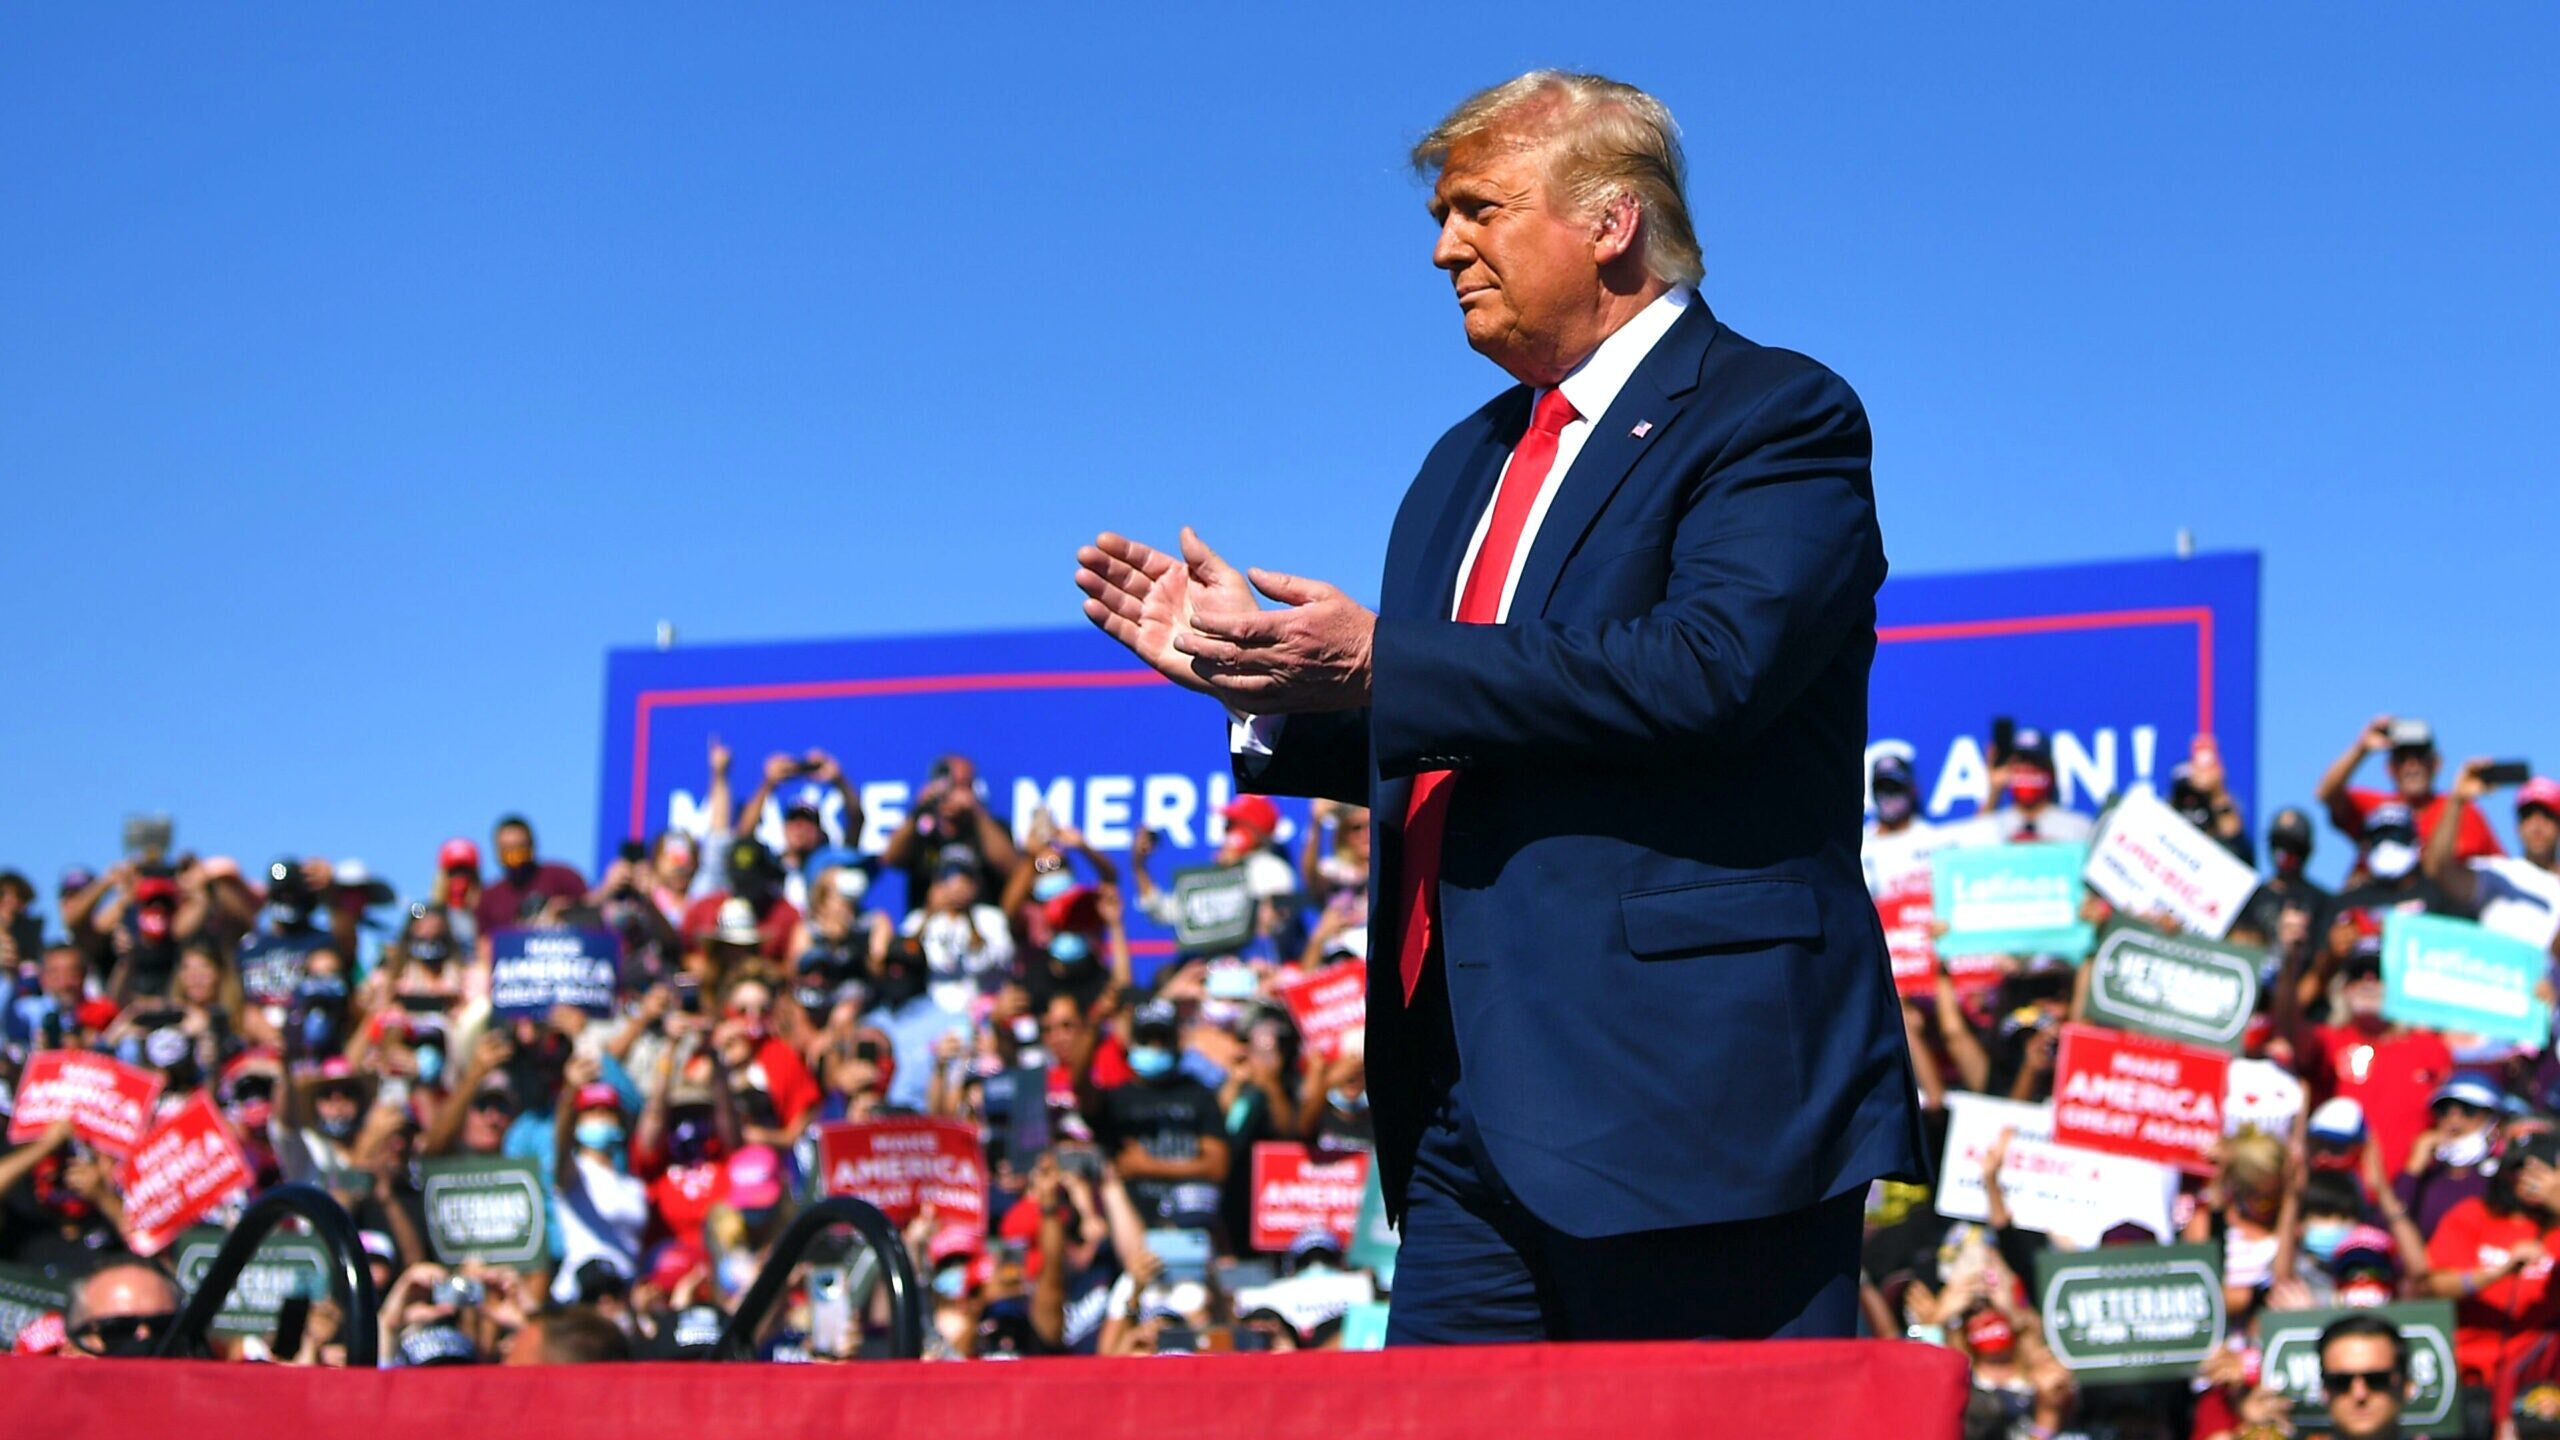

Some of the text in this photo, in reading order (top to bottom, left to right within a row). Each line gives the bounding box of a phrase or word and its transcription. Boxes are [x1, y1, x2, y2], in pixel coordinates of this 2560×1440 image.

[492, 957, 617, 989] AMERICA
[2111, 1051, 2182, 1086] MAKE
[2064, 1069, 2221, 1128] AMERICA
[870, 1130, 938, 1154] MAKE
[831, 1154, 981, 1188] AMERICA
[2068, 1283, 2211, 1329] VETERANS
